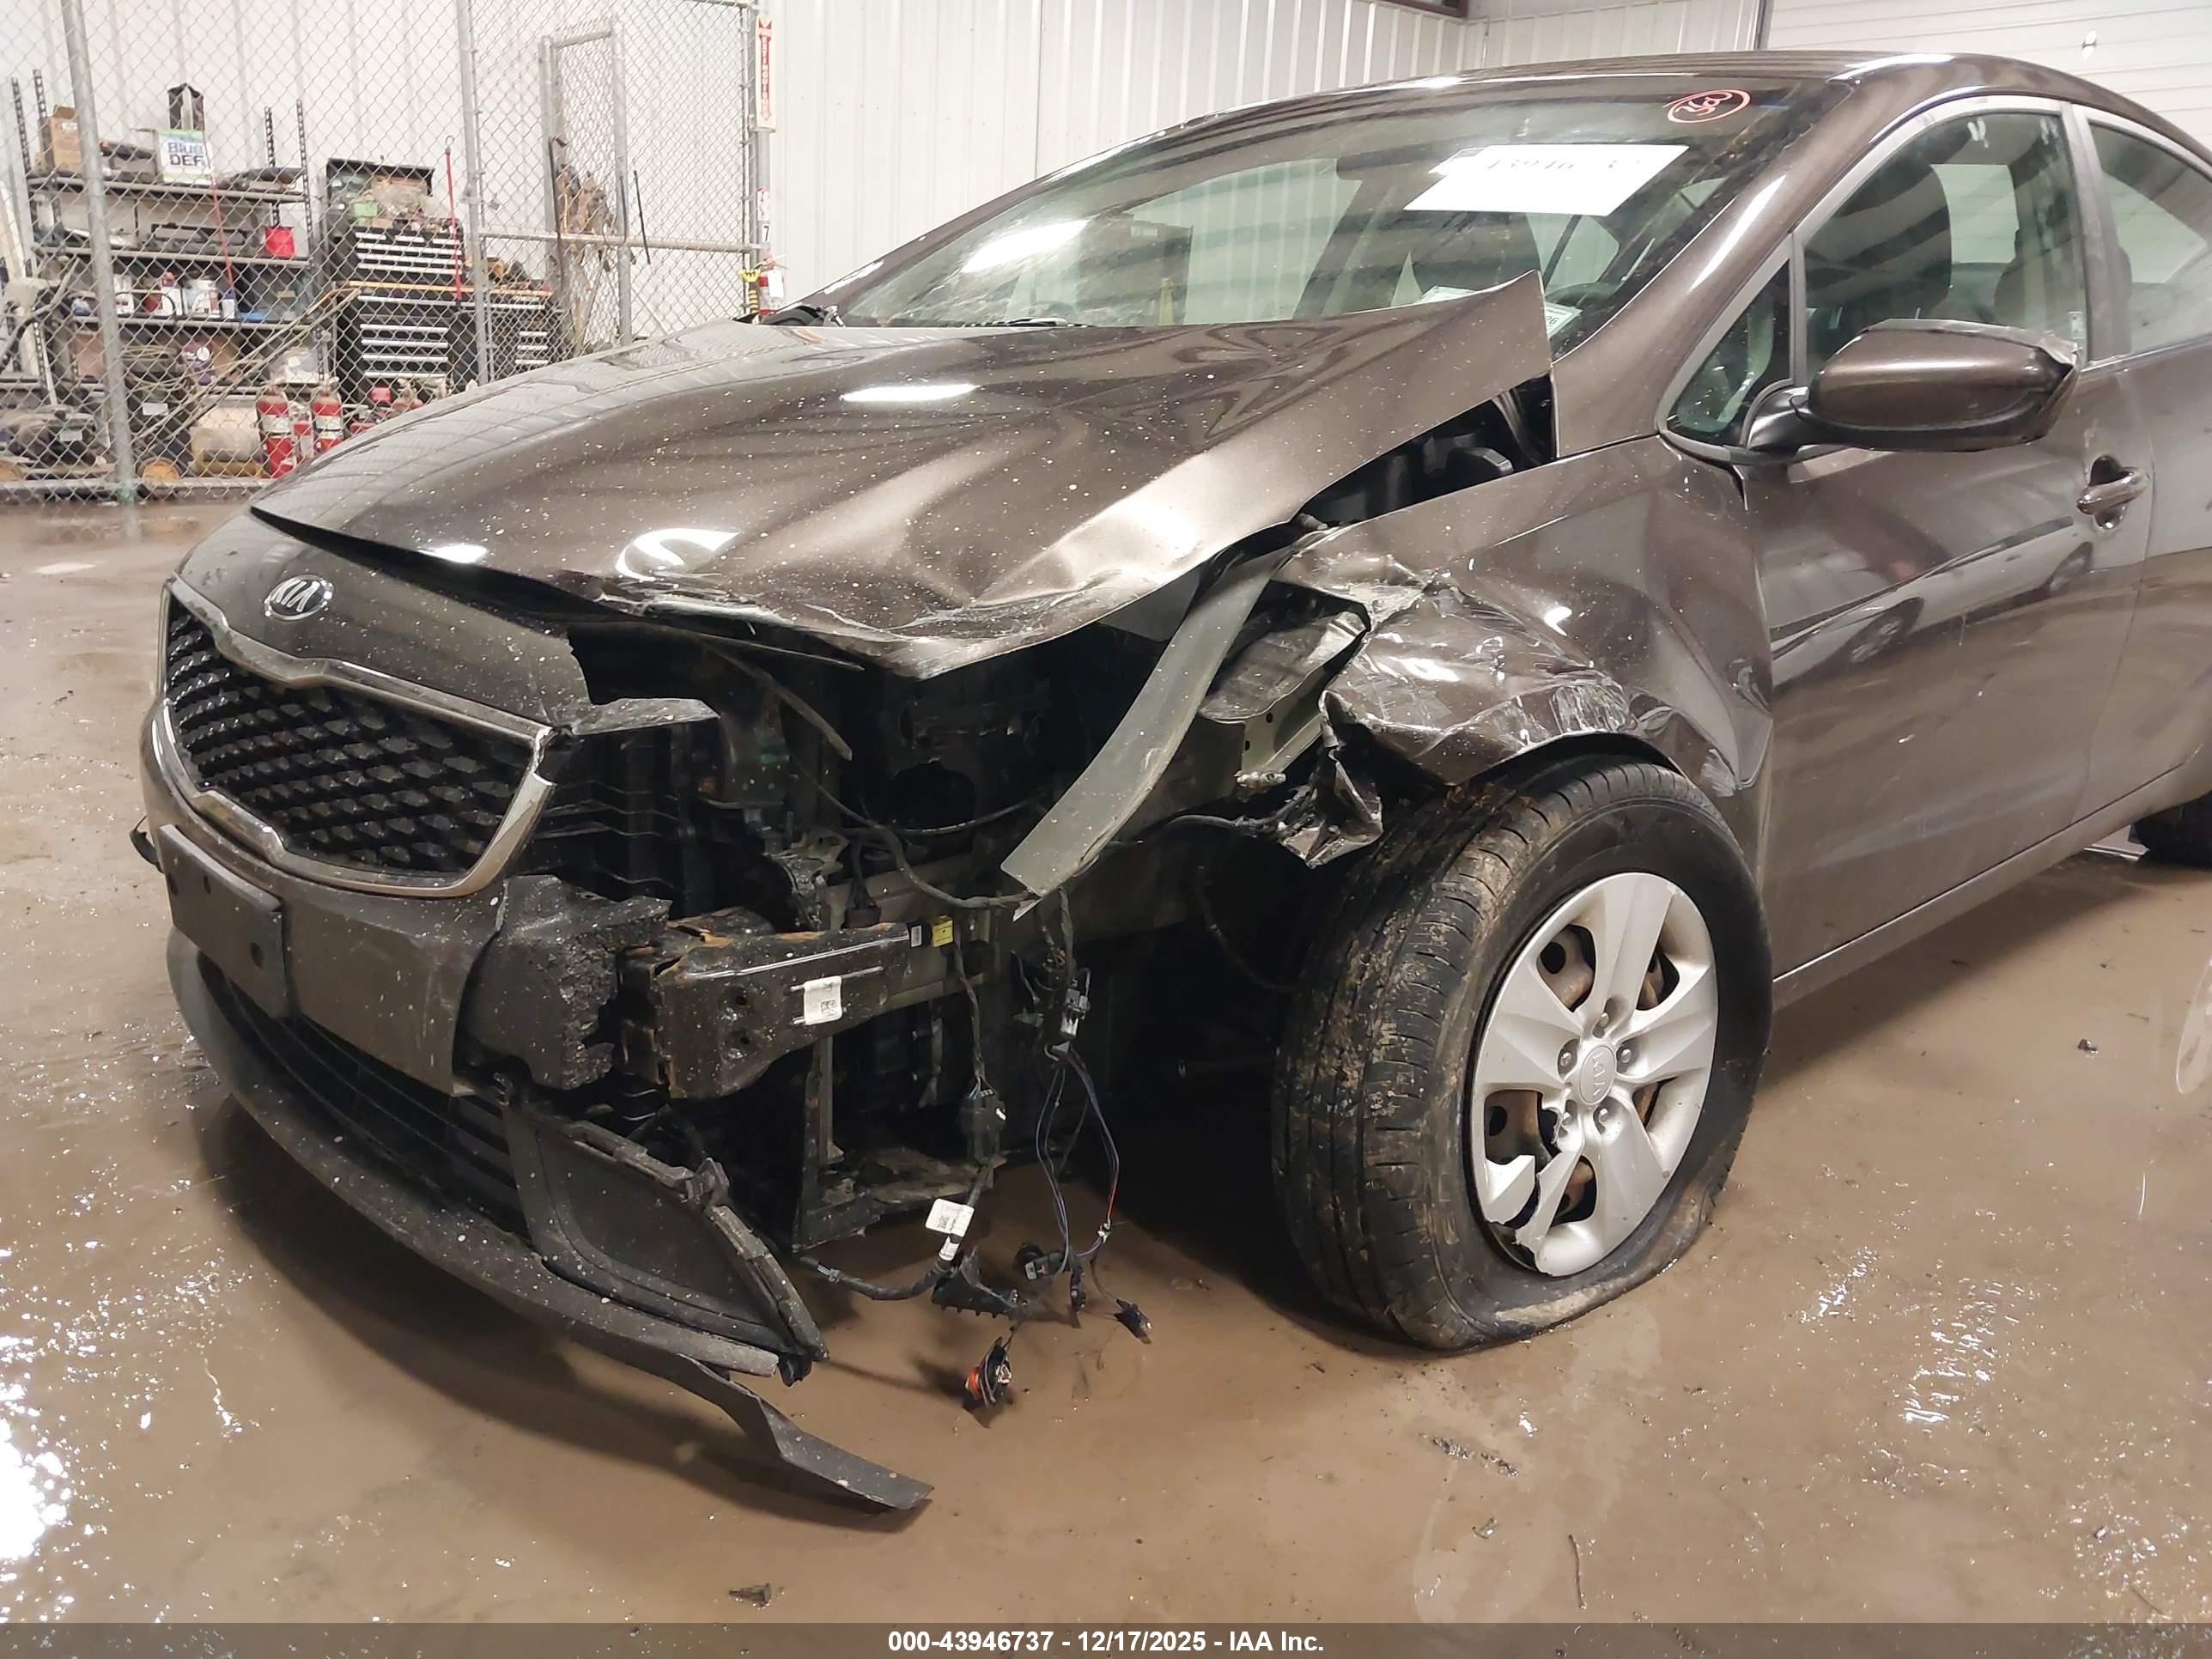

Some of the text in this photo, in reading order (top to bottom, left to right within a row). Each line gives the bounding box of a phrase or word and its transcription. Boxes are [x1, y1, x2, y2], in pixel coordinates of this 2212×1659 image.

[170, 155, 204, 166] DEF
[763, 225, 769, 241] 7
[270, 578, 321, 612] KIA
[1592, 1051, 1607, 1097] KIA
